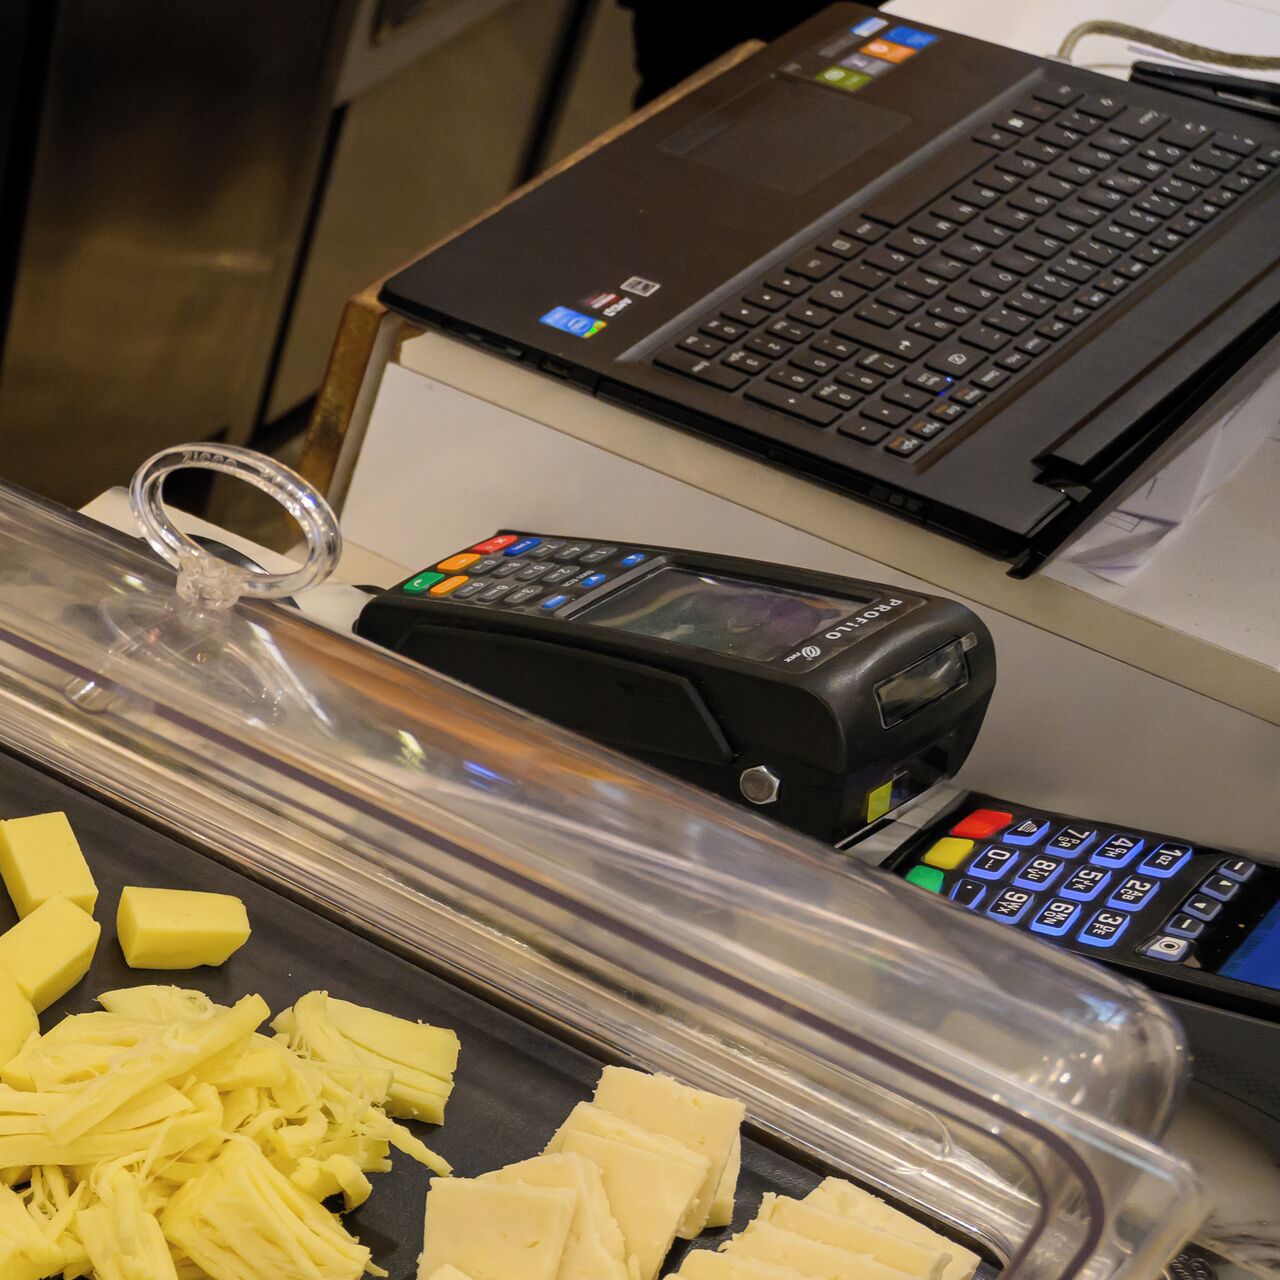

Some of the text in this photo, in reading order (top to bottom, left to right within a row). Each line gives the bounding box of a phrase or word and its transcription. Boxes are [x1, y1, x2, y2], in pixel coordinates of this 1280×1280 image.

[1067, 828, 1090, 839] 7
[1111, 837, 1134, 848] 4
[987, 849, 1011, 860] 0
[1159, 848, 1183, 857] 1
[1032, 859, 1057, 871] 8
[1078, 869, 1104, 881] 5
[1125, 879, 1152, 891] 2
[1004, 891, 1029, 903] 9
[1050, 902, 1075, 914] 6
[1098, 913, 1123, 925] 3
